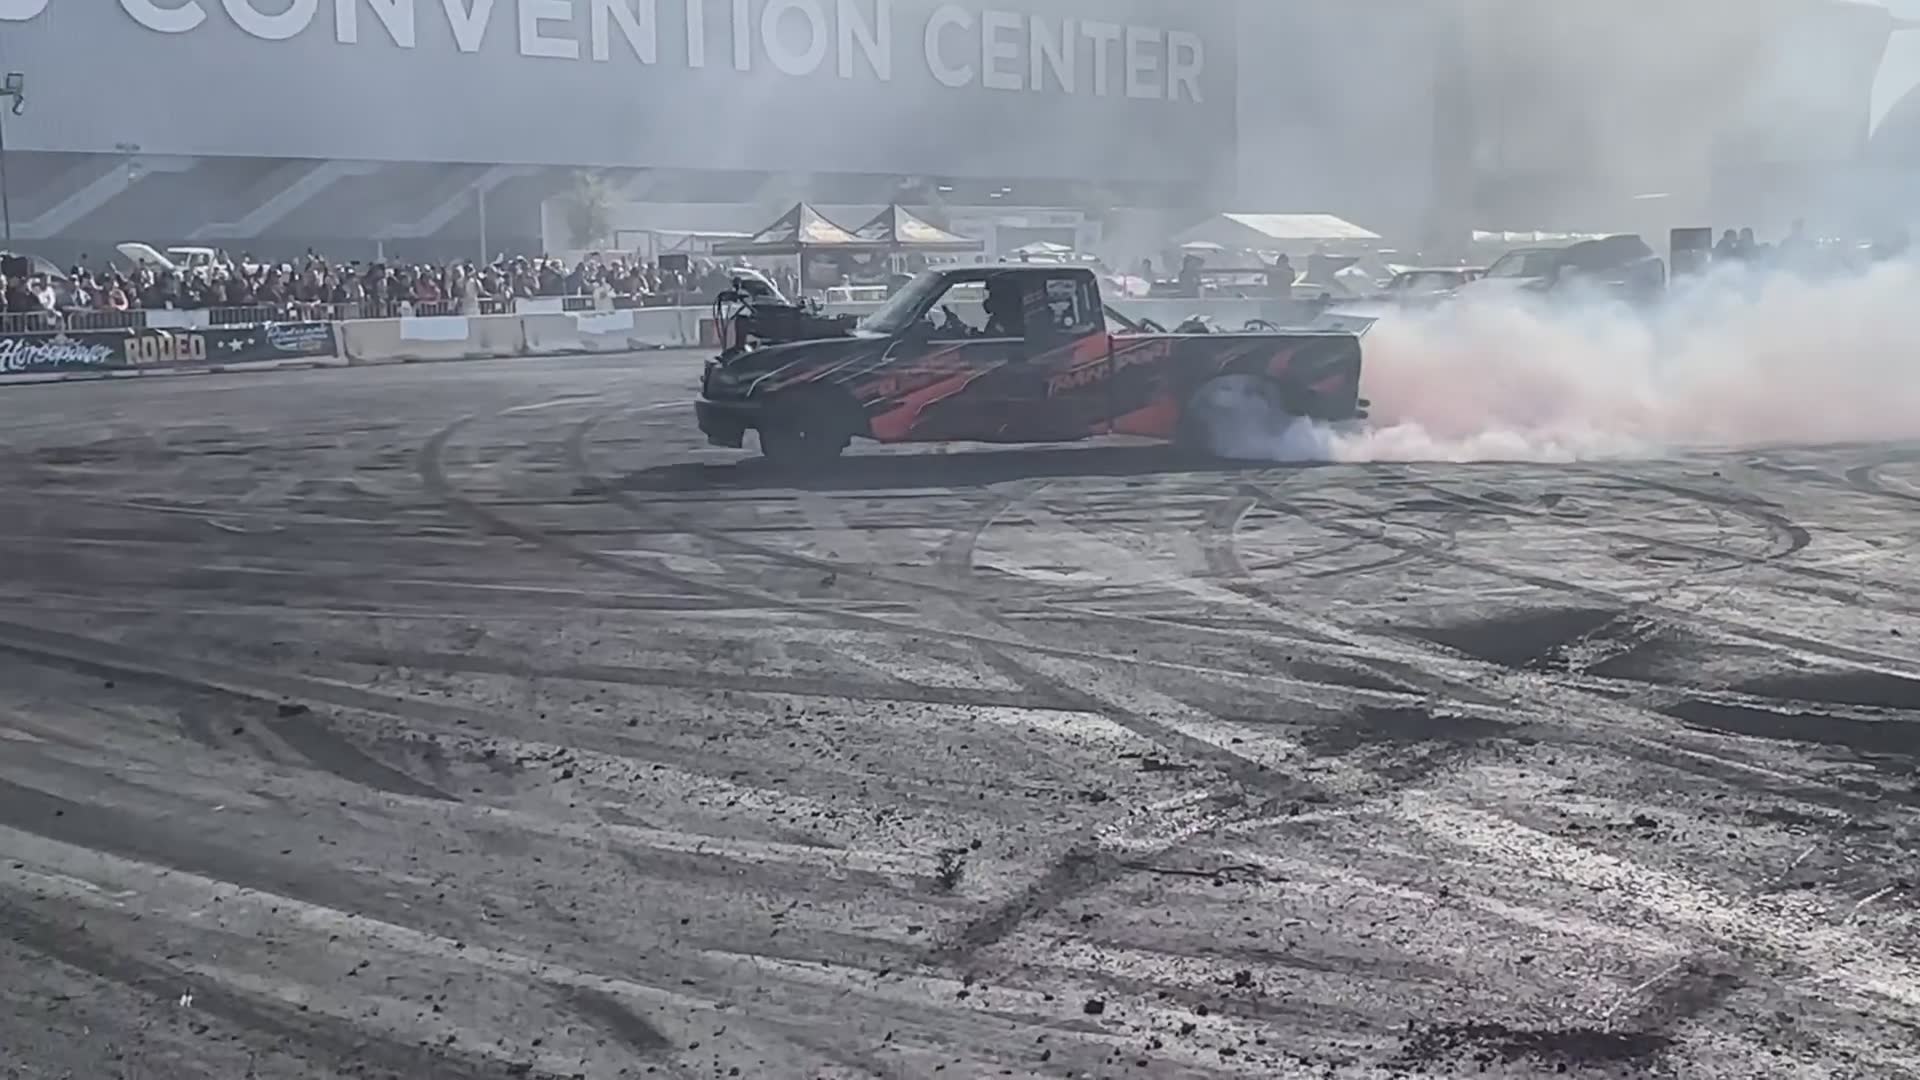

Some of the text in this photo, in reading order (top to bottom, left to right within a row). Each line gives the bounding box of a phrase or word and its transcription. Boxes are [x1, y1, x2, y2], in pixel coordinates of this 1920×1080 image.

[117, 0, 1205, 104] VENTION CENTER
[0, 333, 206, 371] Horsepower RODEO
